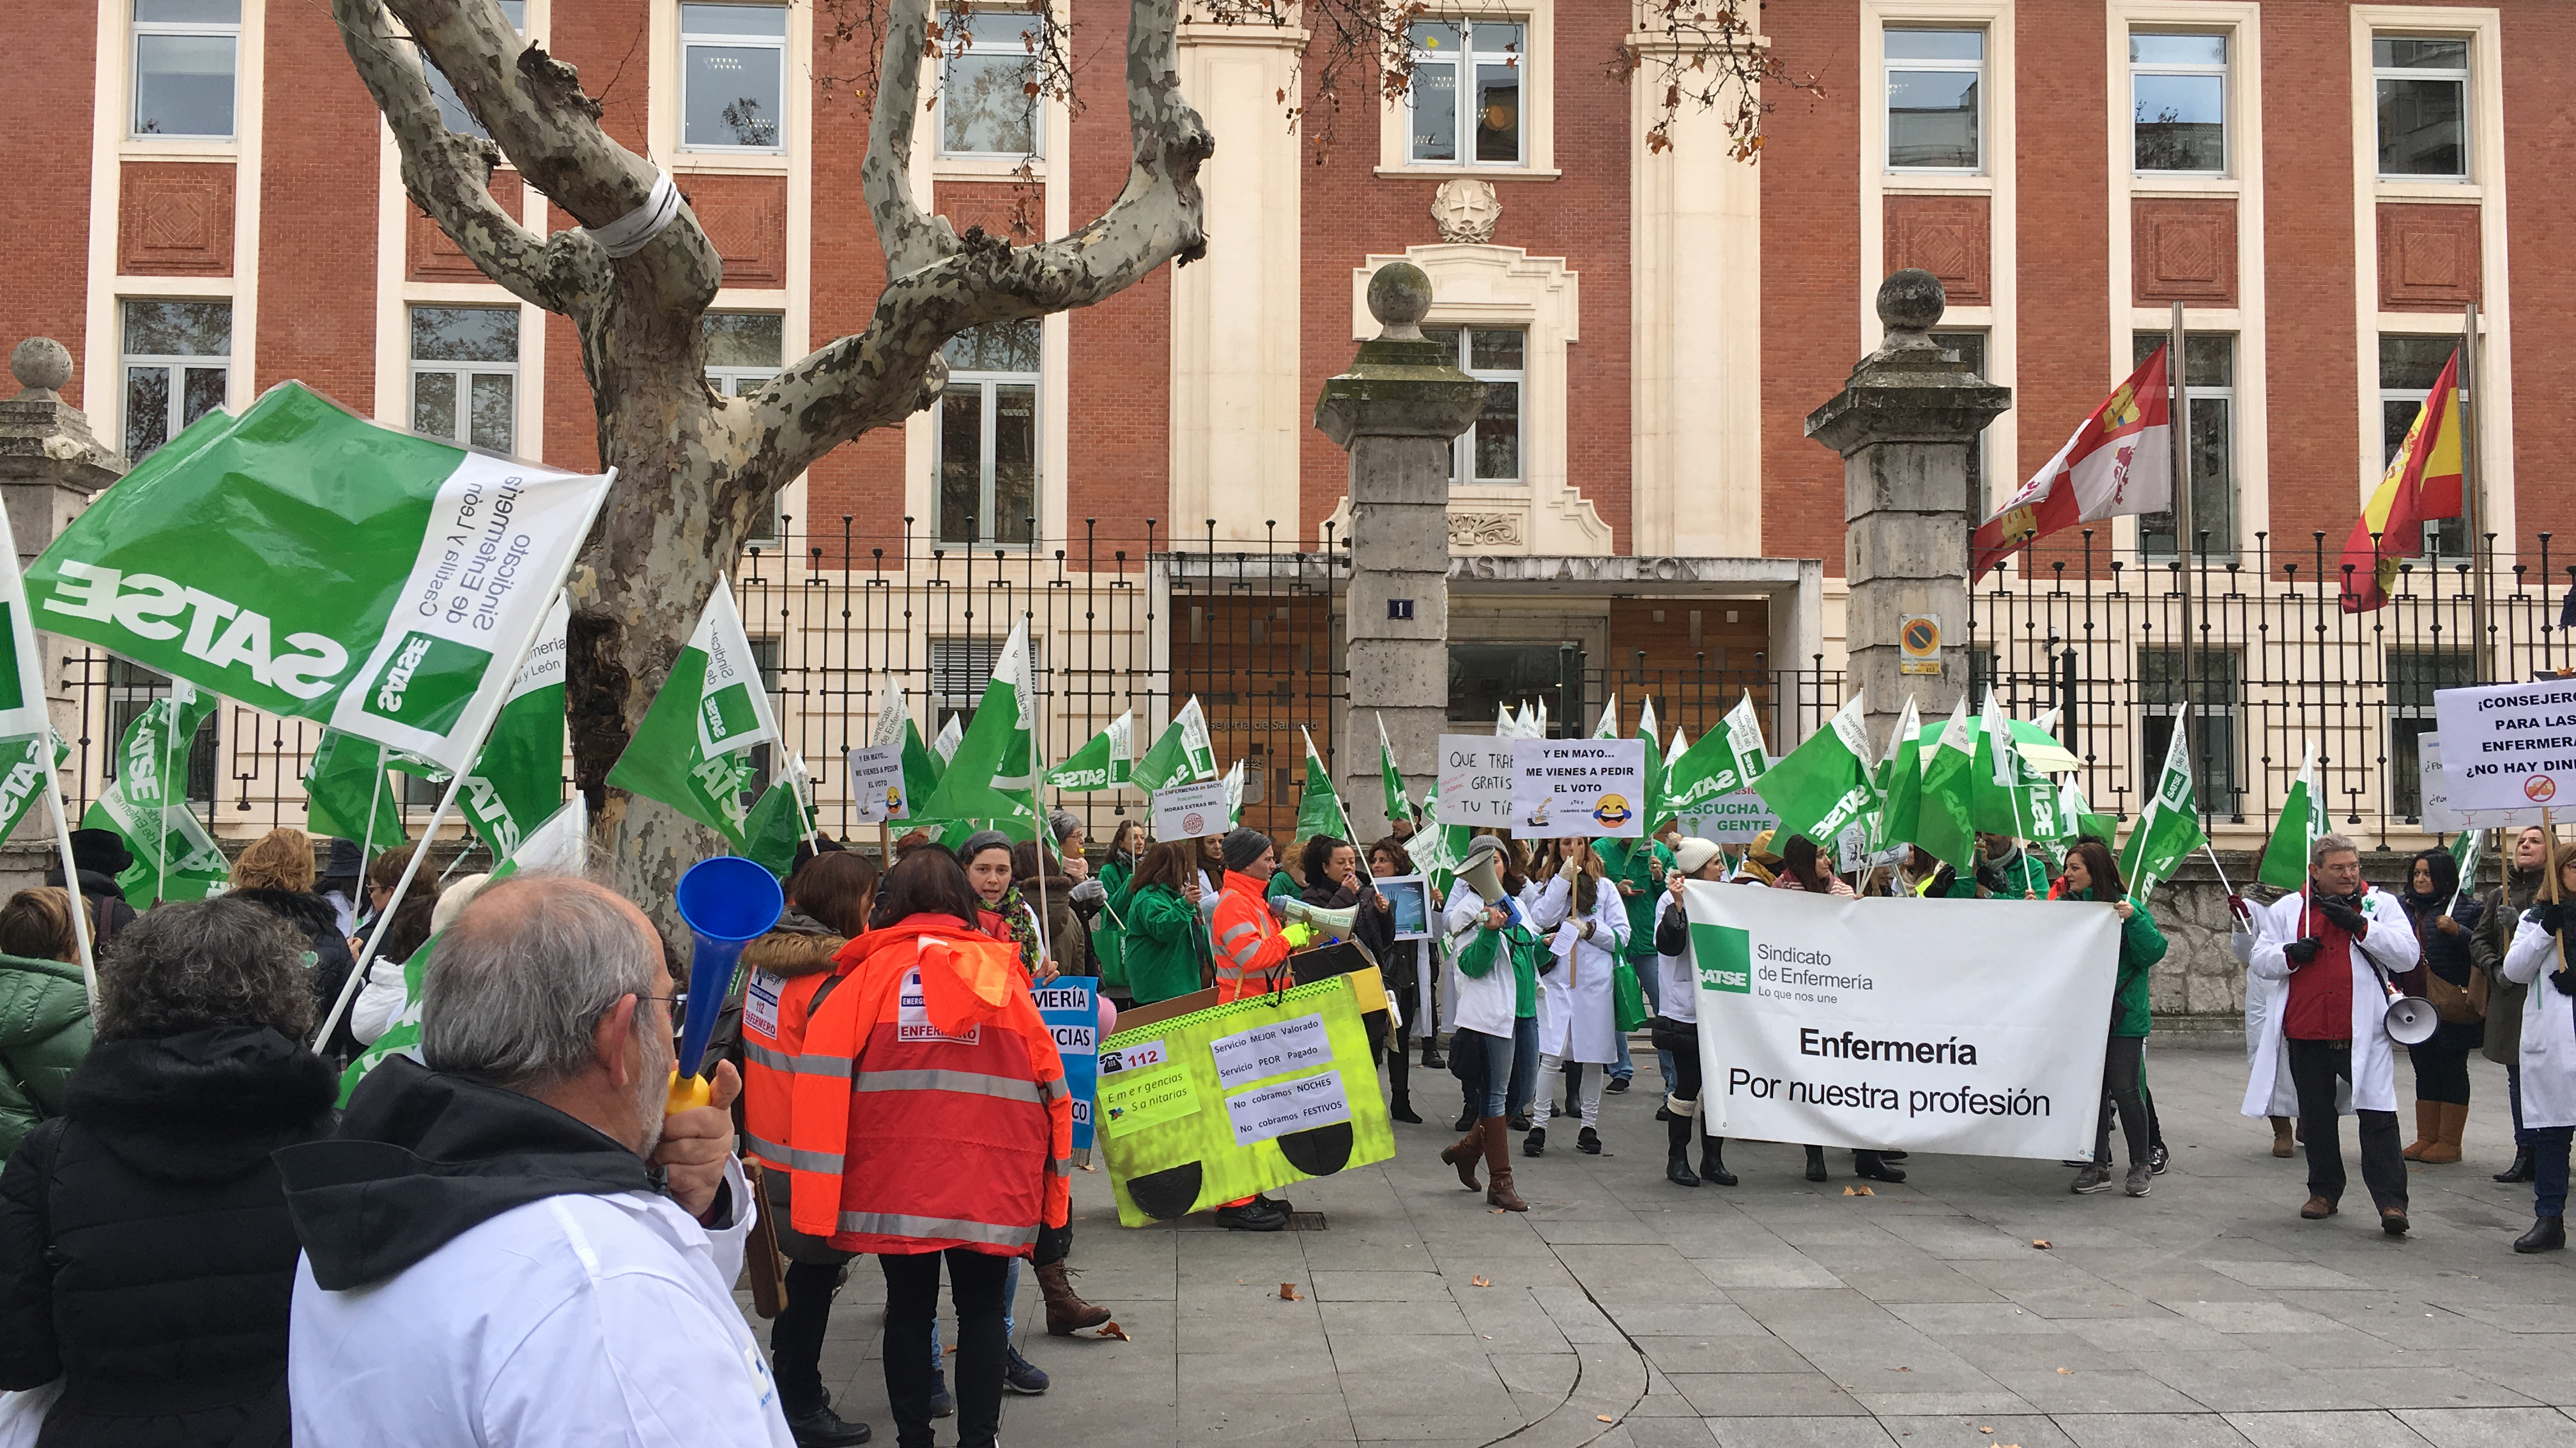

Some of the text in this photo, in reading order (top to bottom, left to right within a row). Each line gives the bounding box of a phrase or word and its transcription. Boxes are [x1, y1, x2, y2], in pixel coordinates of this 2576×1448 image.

[1446, 555, 1574, 580] ASTILLA
[527, 637, 567, 662] mería
[531, 659, 560, 676] León
[2495, 714, 2576, 730] PARA LAS
[2482, 737, 2576, 752] ENFERMER
[1450, 751, 1477, 767] QUE
[1543, 749, 1614, 759] Y EN MAYO...
[1526, 767, 1634, 776] ME VIENES A PEDIR
[2466, 764, 2499, 778] ¿NO
[2504, 761, 2538, 773] HAY
[875, 779, 887, 787] VOTO
[1165, 786, 1199, 795] ENFERMERAS
[1554, 784, 1602, 793] EL VOTO
[2166, 773, 2183, 799] SATSE
[1177, 794, 1203, 802] hacemos
[1461, 800, 1481, 812] TU
[1164, 805, 1184, 813] HORAS
[1717, 820, 1772, 831] GENTE
[1758, 944, 1831, 966] Sindicato
[1758, 966, 1873, 990] de Enfermería
[1031, 985, 1085, 1008] MERÍA
[1758, 986, 1837, 1004] Lo que nos une
[756, 1001, 765, 1014] 112
[745, 1010, 776, 1035] ENFERMERO
[901, 1026, 977, 1040] ENFERRO
[1215, 1020, 1319, 1054] Servicio MEJOR Valorado
[1800, 1028, 1977, 1065] Enfermería
[1128, 1050, 1158, 1067] 112
[1220, 1045, 1318, 1077] Servicio PEOR Pagado
[1233, 1078, 1331, 1109] No cobramos NOCHES
[1729, 1068, 2050, 1118] Por nuestra profesión
[1071, 1101, 1087, 1121] CO
[1239, 1101, 1342, 1134] No cobramos FESTIVOS
